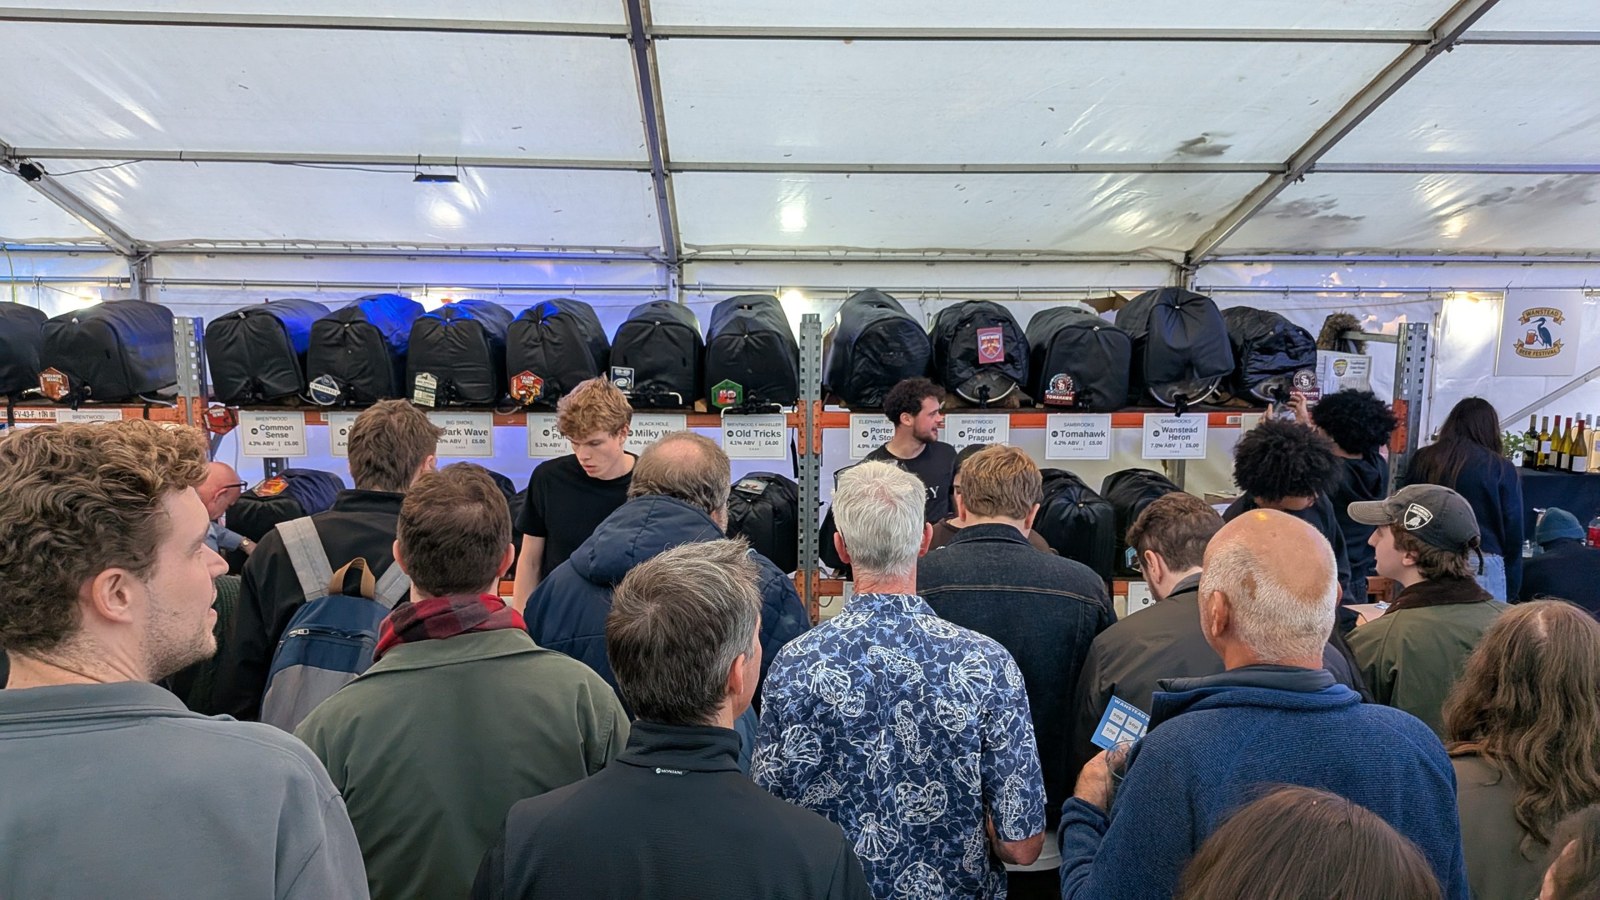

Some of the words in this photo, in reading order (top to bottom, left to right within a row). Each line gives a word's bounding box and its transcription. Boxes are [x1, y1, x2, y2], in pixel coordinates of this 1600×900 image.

[1525, 309, 1559, 317] WANSTEAD
[1534, 349, 1558, 357] FESTIVAL
[635, 430, 659, 439] Milky
[1114, 698, 1146, 720] WANSTEAD
